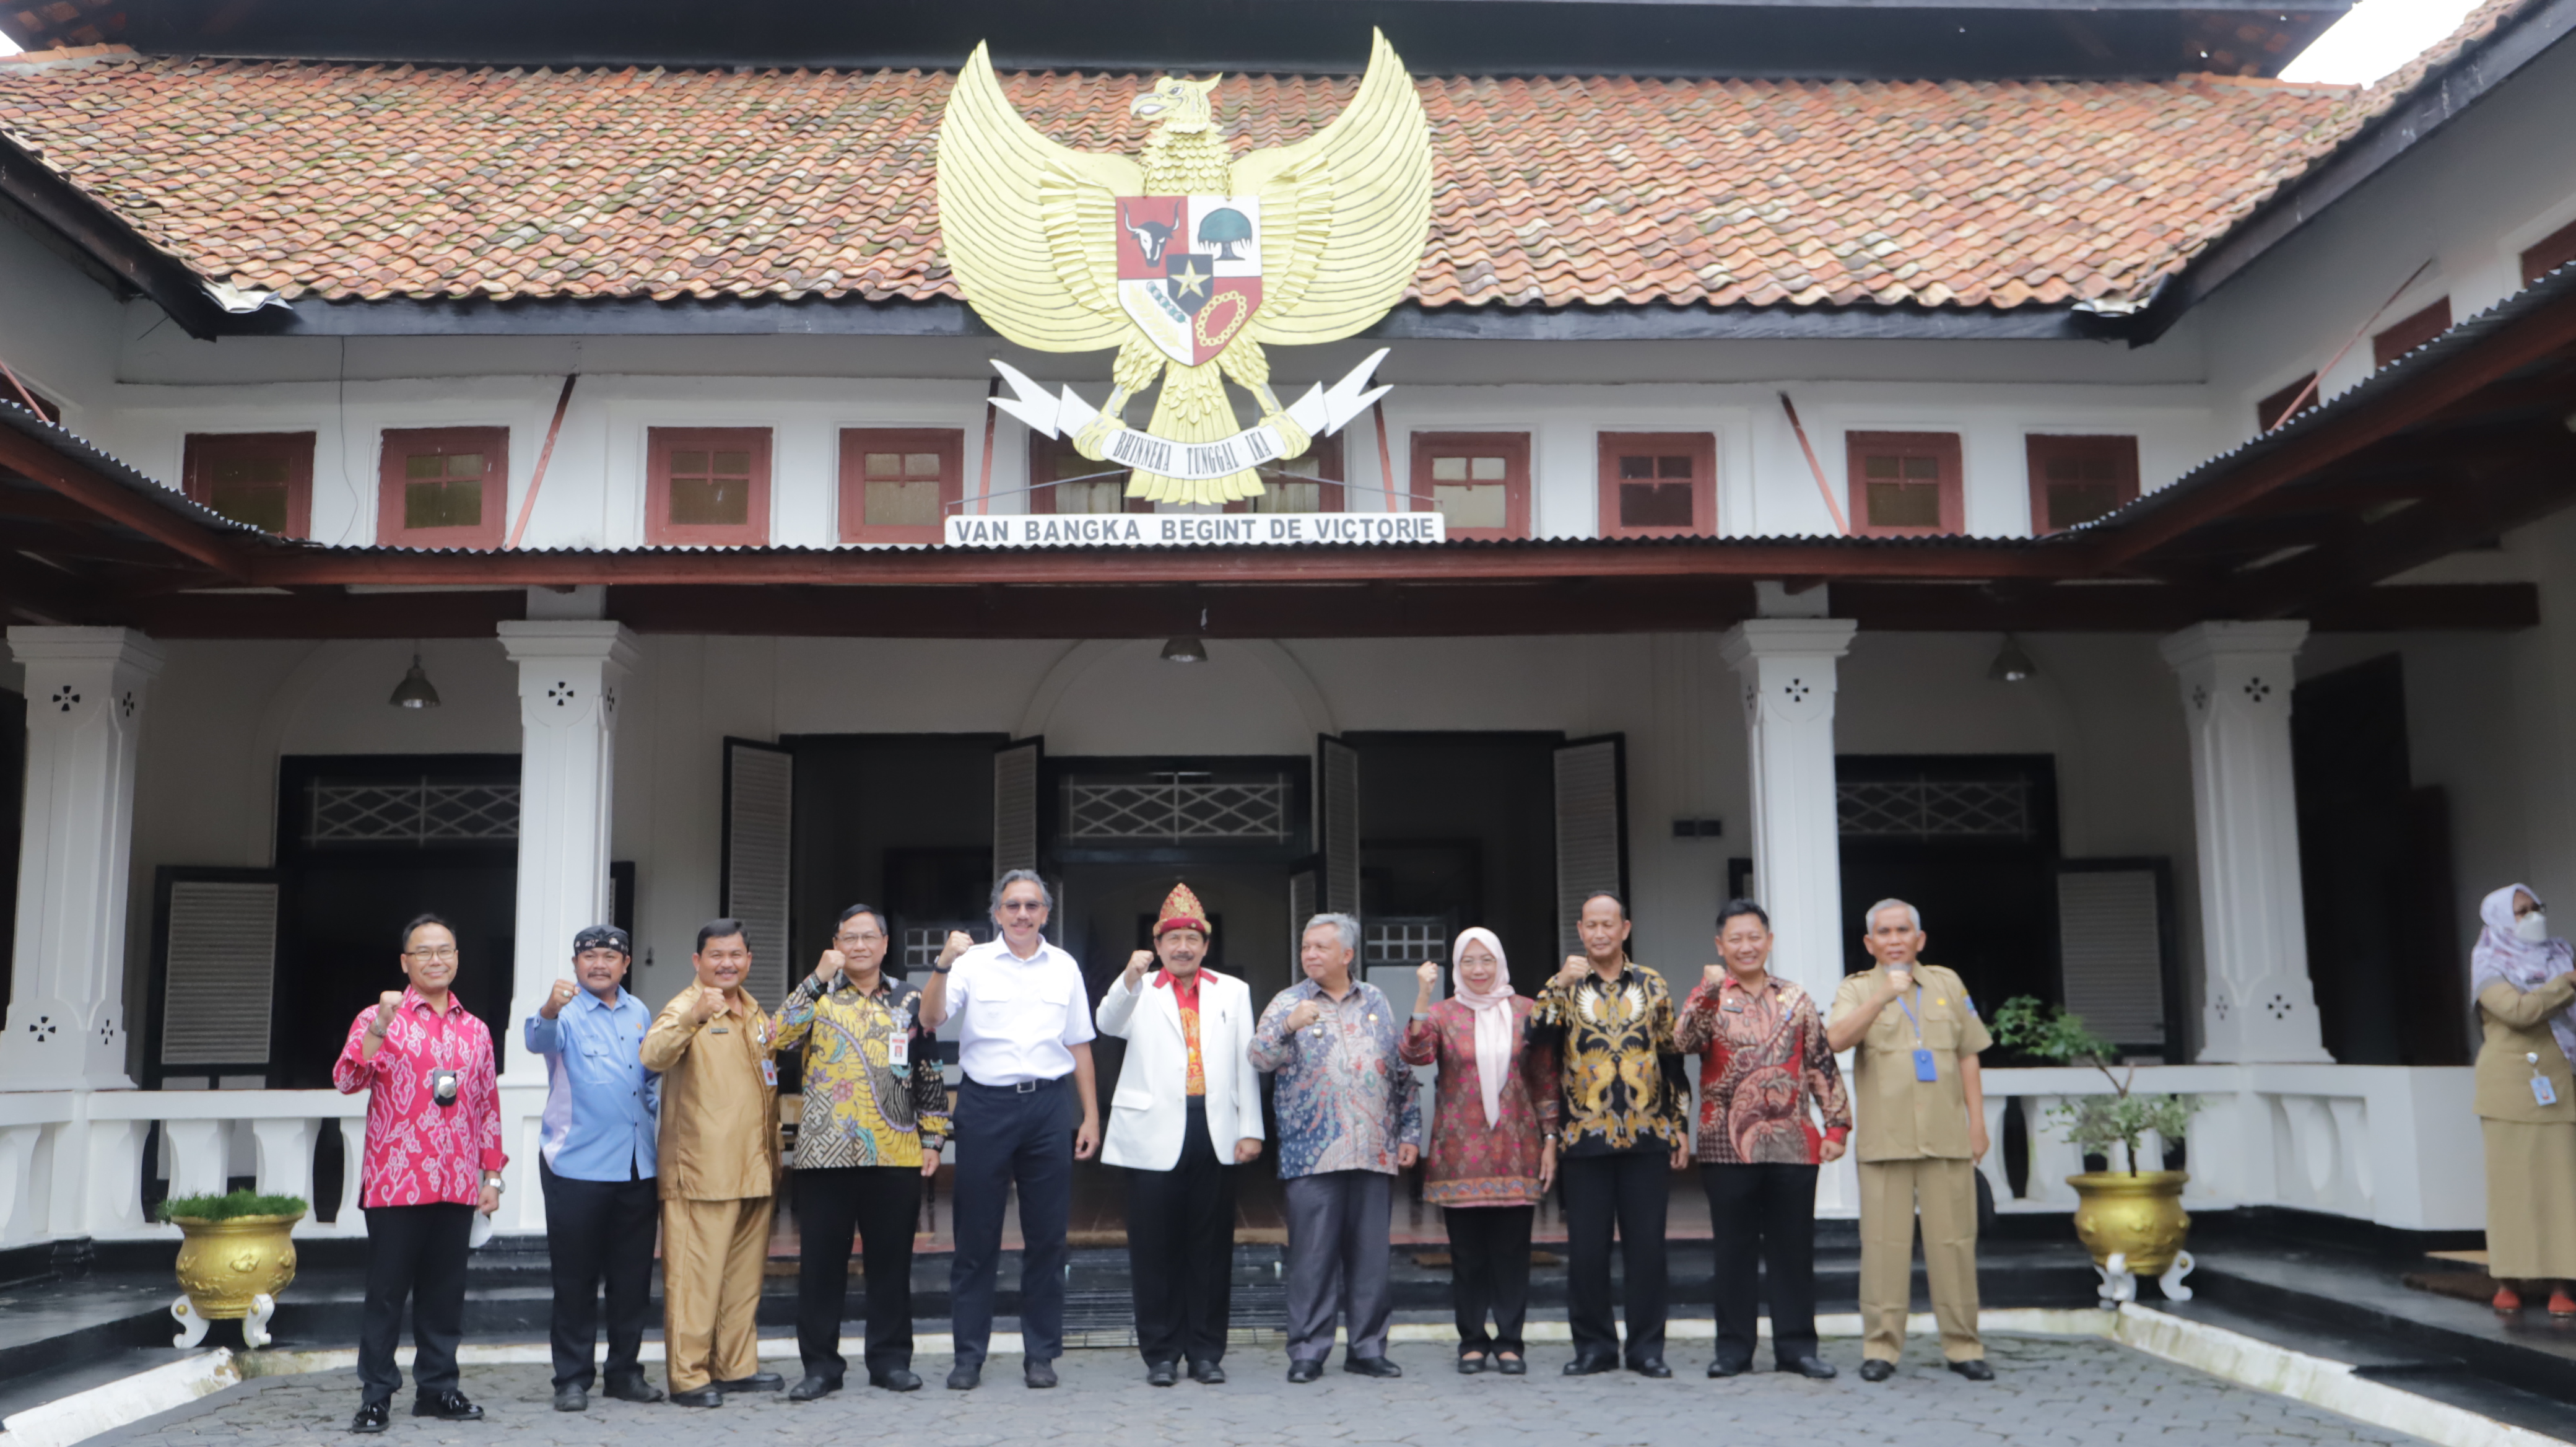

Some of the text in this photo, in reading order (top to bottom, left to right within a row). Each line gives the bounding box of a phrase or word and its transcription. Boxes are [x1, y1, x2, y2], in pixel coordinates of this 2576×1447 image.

[1113, 431, 1272, 474] BHINNEKA TUNGGAL IKA
[955, 518, 1434, 542] VAN BANGKA BEGINT DE VICTORIE
